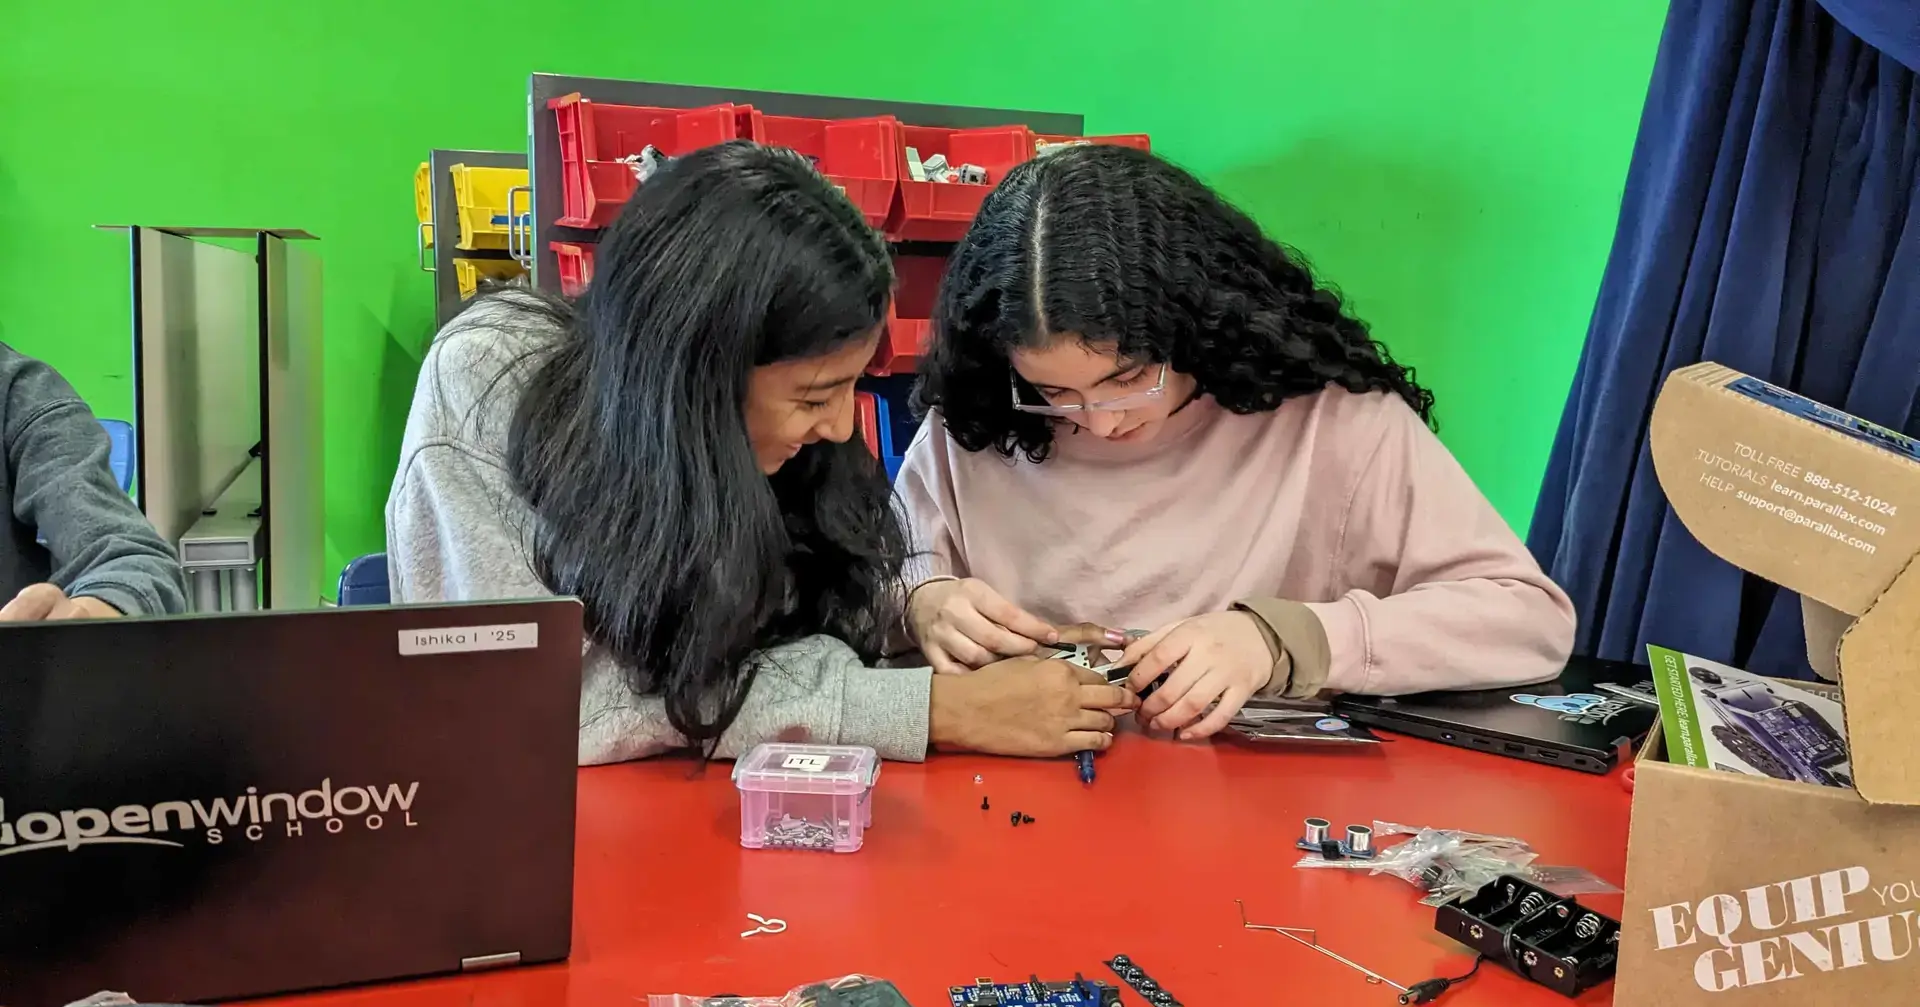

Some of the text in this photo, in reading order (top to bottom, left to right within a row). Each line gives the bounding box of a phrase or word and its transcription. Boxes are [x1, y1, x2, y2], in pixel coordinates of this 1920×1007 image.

[1698, 448, 1887, 536] TUTORIALS learn.parallax.com
[1700, 472, 1877, 555] HELP support@parallax.com
[1734, 442, 1897, 517] TOLL FREE 888-512-1024
[415, 634, 466, 646] Ishika
[490, 629, 516, 642] '25
[1664, 654, 1677, 670] GET
[788, 758, 820, 766] ITL
[16, 777, 419, 852] openwindow
[206, 812, 418, 844] SCHOOL
[1648, 866, 1870, 951] EQUIP
[1693, 910, 1920, 992] GENIU
